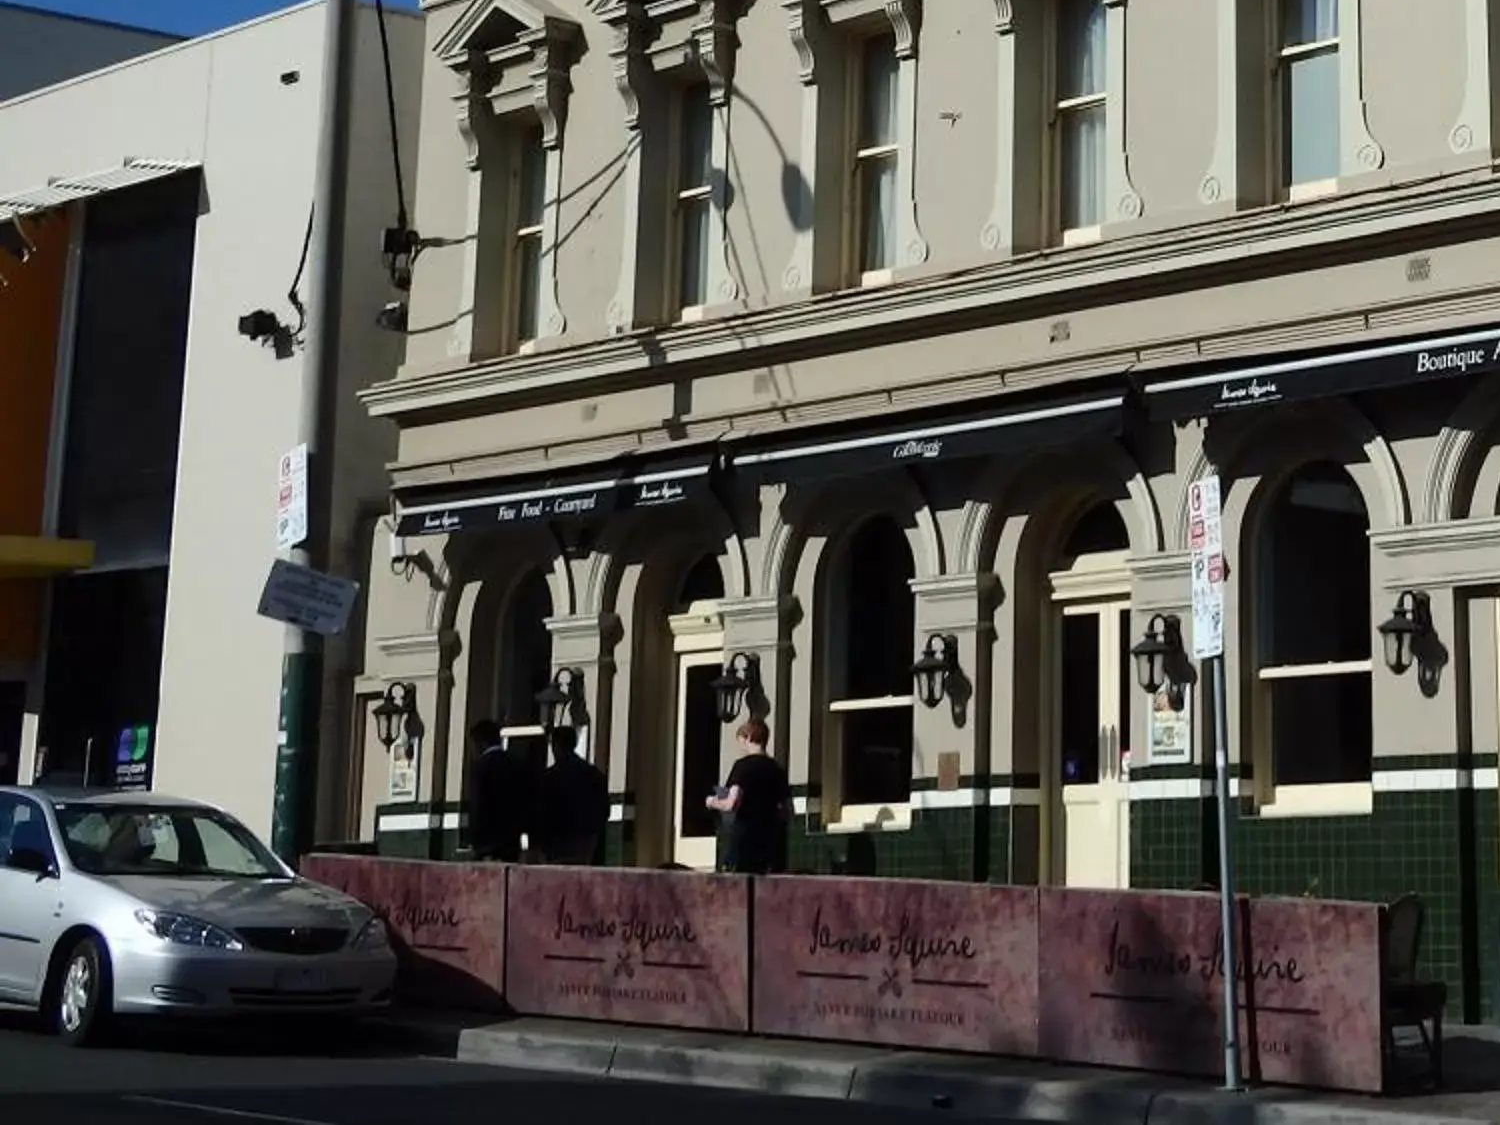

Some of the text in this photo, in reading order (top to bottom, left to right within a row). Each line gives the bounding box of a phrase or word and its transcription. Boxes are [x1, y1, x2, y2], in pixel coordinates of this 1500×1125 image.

[1416, 347, 1485, 373] Boutique
[553, 893, 697, 952] James Squire
[808, 904, 977, 968] James Squire
[1104, 920, 1190, 976] James
